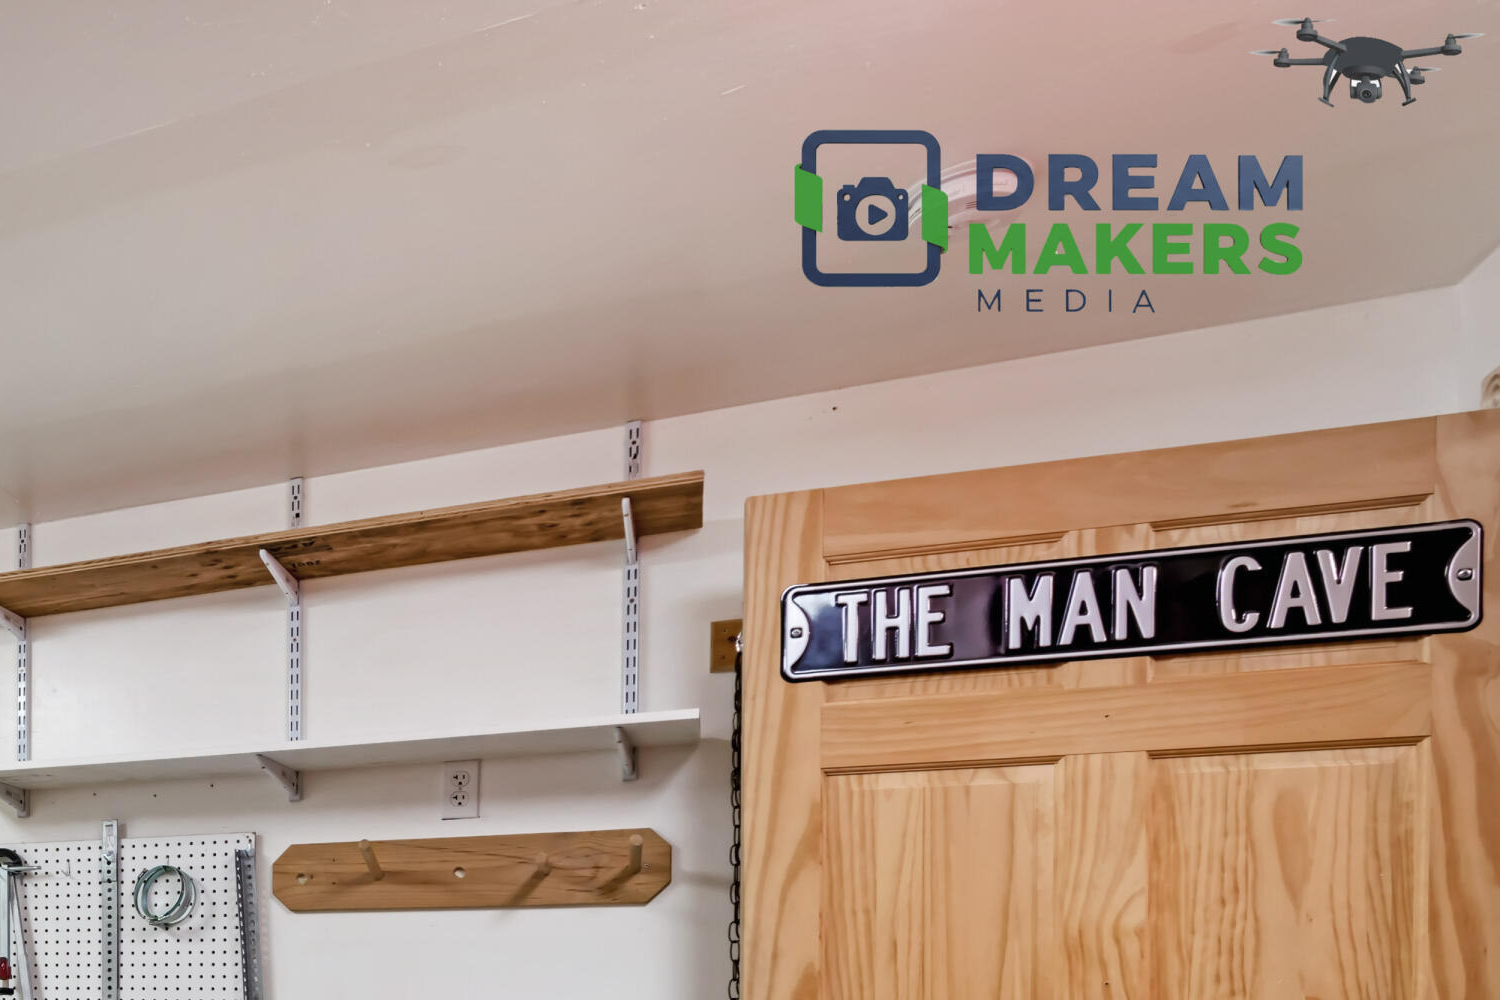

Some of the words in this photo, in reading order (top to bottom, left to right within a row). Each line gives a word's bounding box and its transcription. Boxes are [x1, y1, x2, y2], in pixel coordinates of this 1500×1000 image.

[835, 584, 951, 664] THE
[1006, 567, 1158, 650] MAN
[1217, 540, 1413, 633] CAVE
